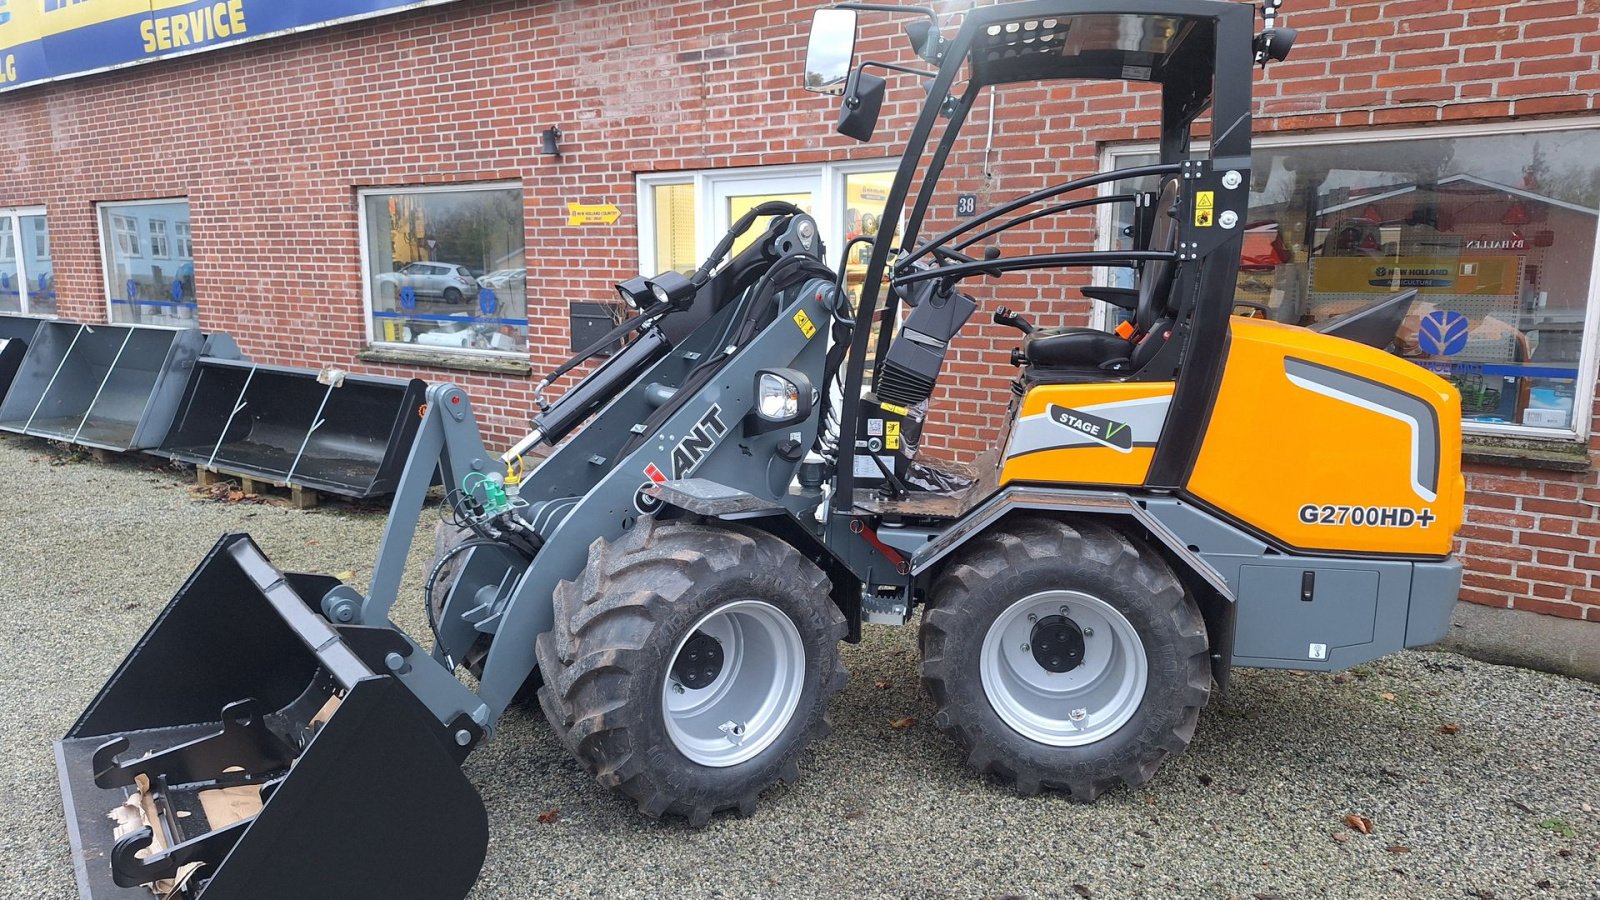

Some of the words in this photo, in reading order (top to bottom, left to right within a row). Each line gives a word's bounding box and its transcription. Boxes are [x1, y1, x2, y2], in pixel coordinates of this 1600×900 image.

[140, 0, 247, 53] SERVICE
[959, 197, 974, 213] 38
[1409, 268, 1449, 276] HOLLAND
[1059, 412, 1101, 436] STAGE
[1105, 421, 1129, 440] V
[1299, 503, 1436, 528] G2700HD+
